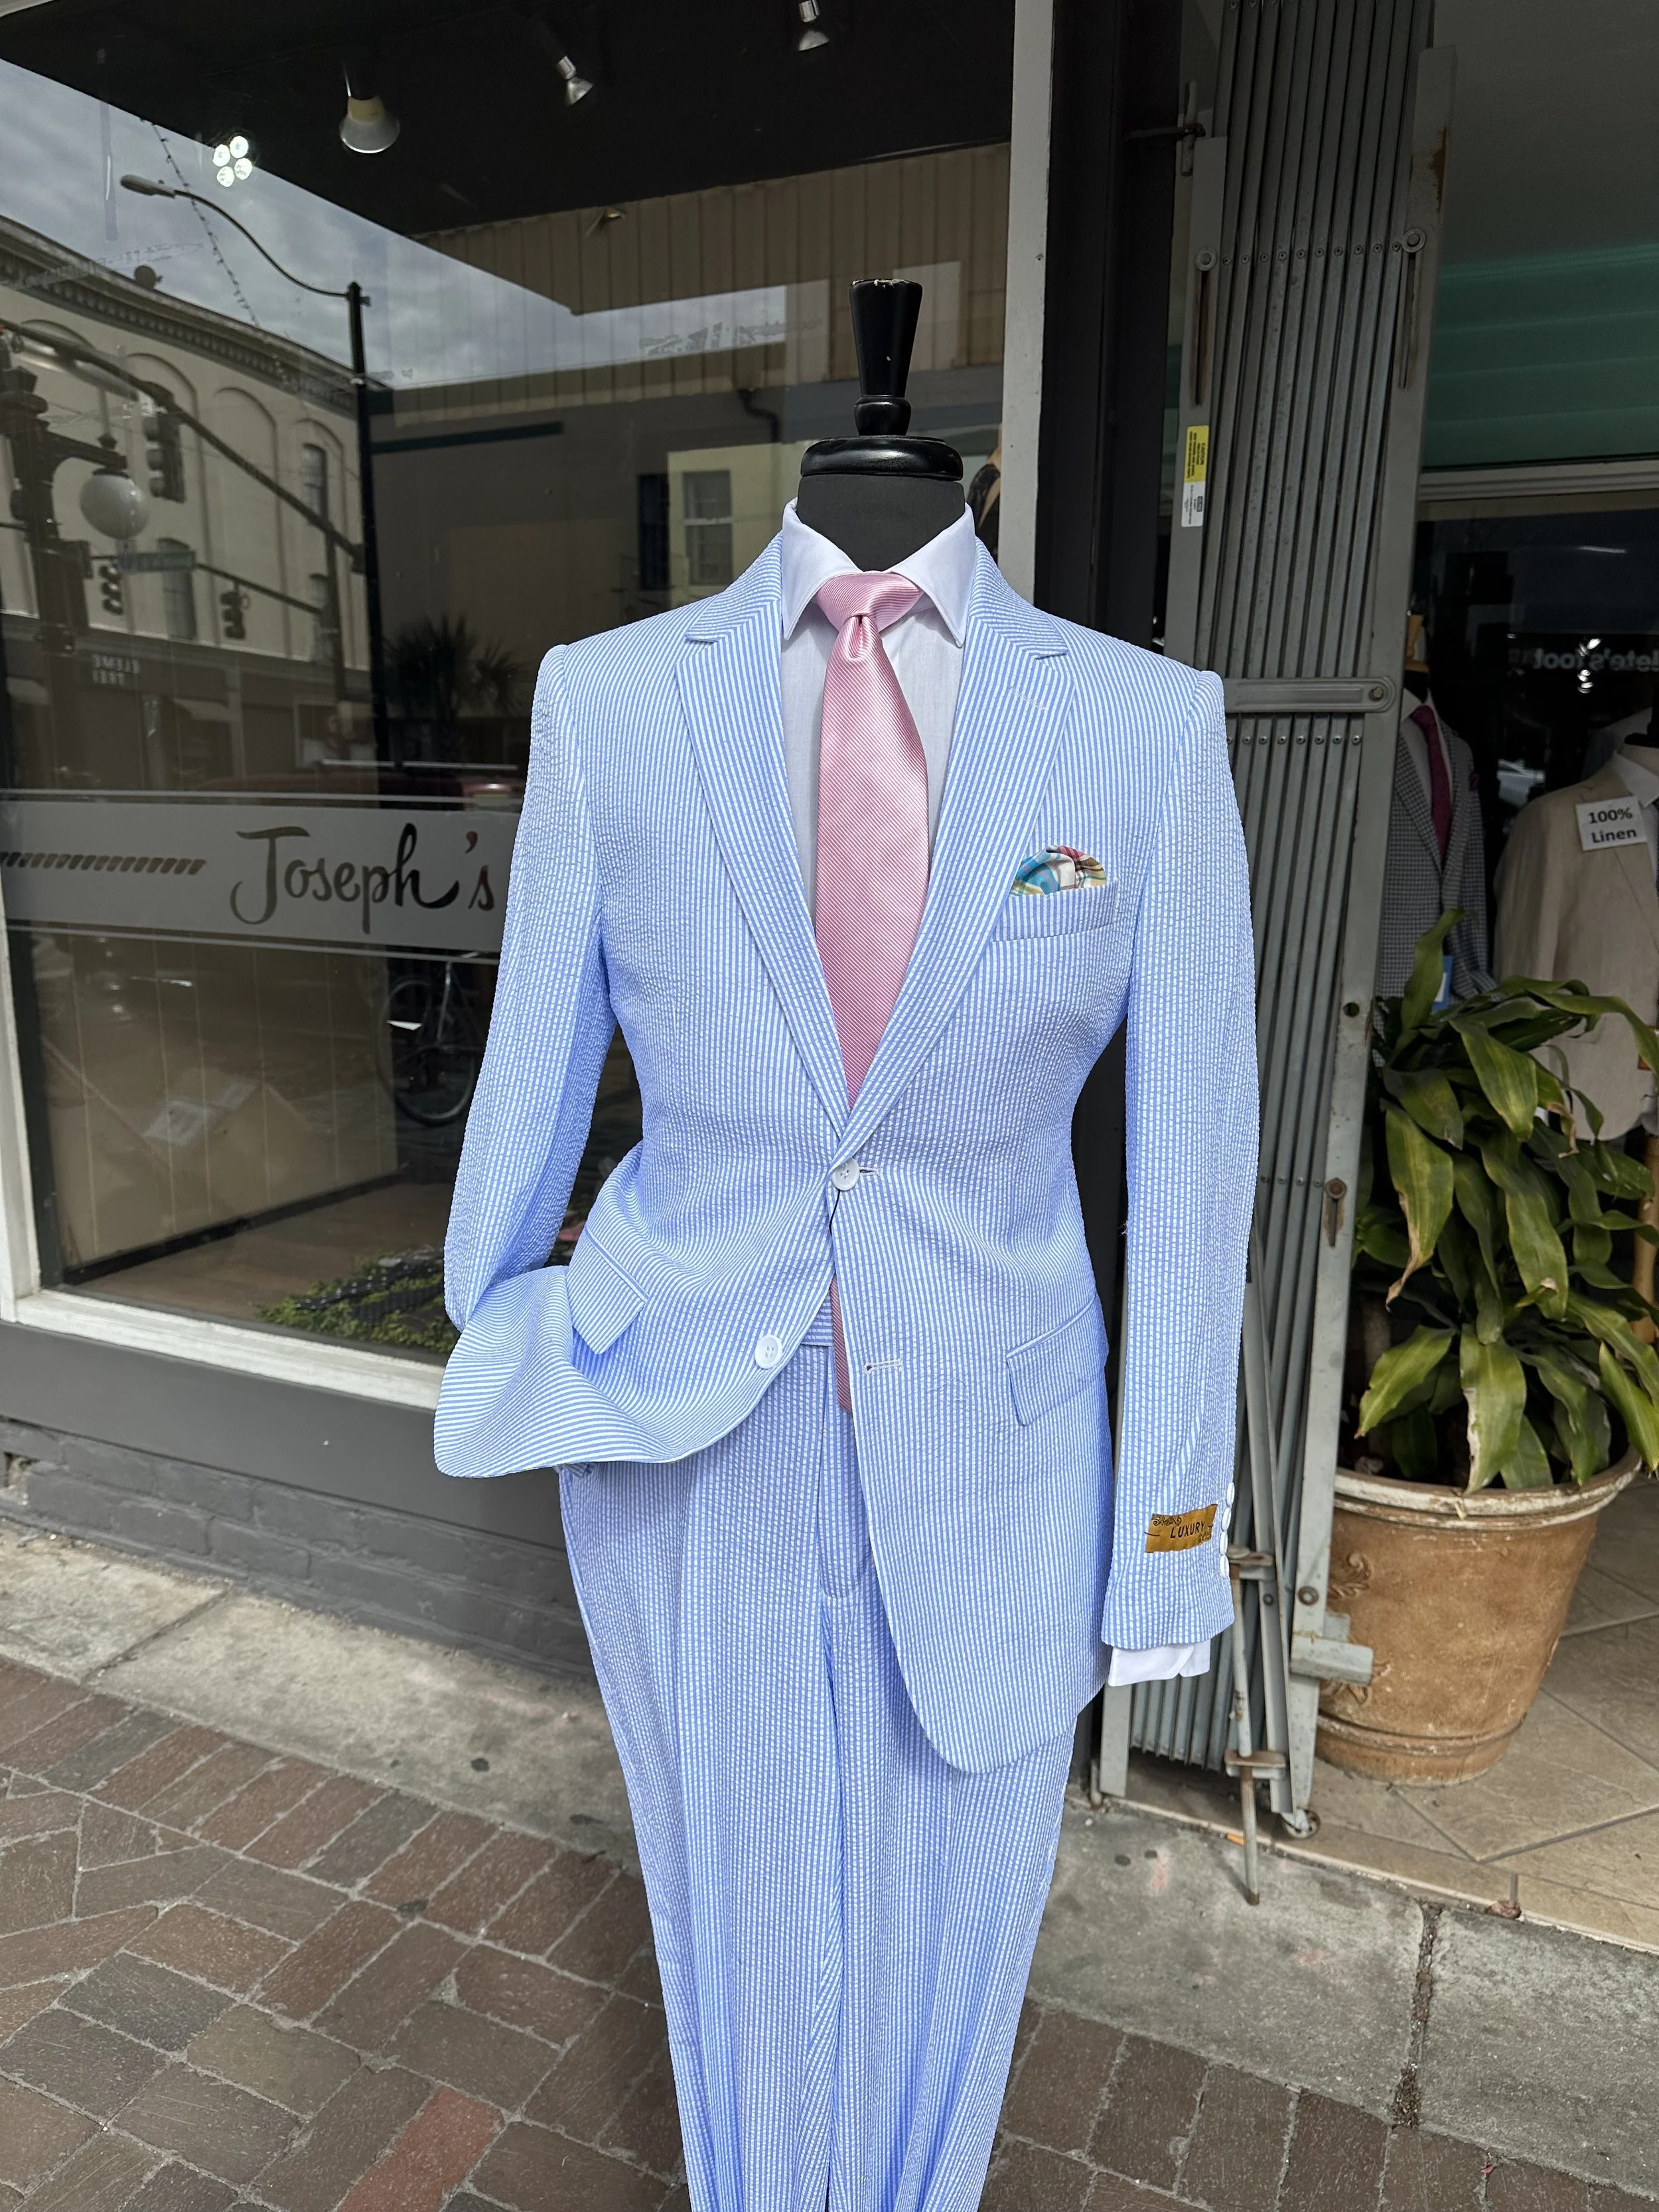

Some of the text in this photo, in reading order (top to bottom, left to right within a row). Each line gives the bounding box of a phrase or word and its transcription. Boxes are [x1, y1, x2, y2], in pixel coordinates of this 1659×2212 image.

[1588, 806, 1633, 824] 100%
[1591, 828, 1637, 844] Linen
[230, 822, 495, 935] Joseph's
[1170, 1520, 1205, 1539] LUXURY
